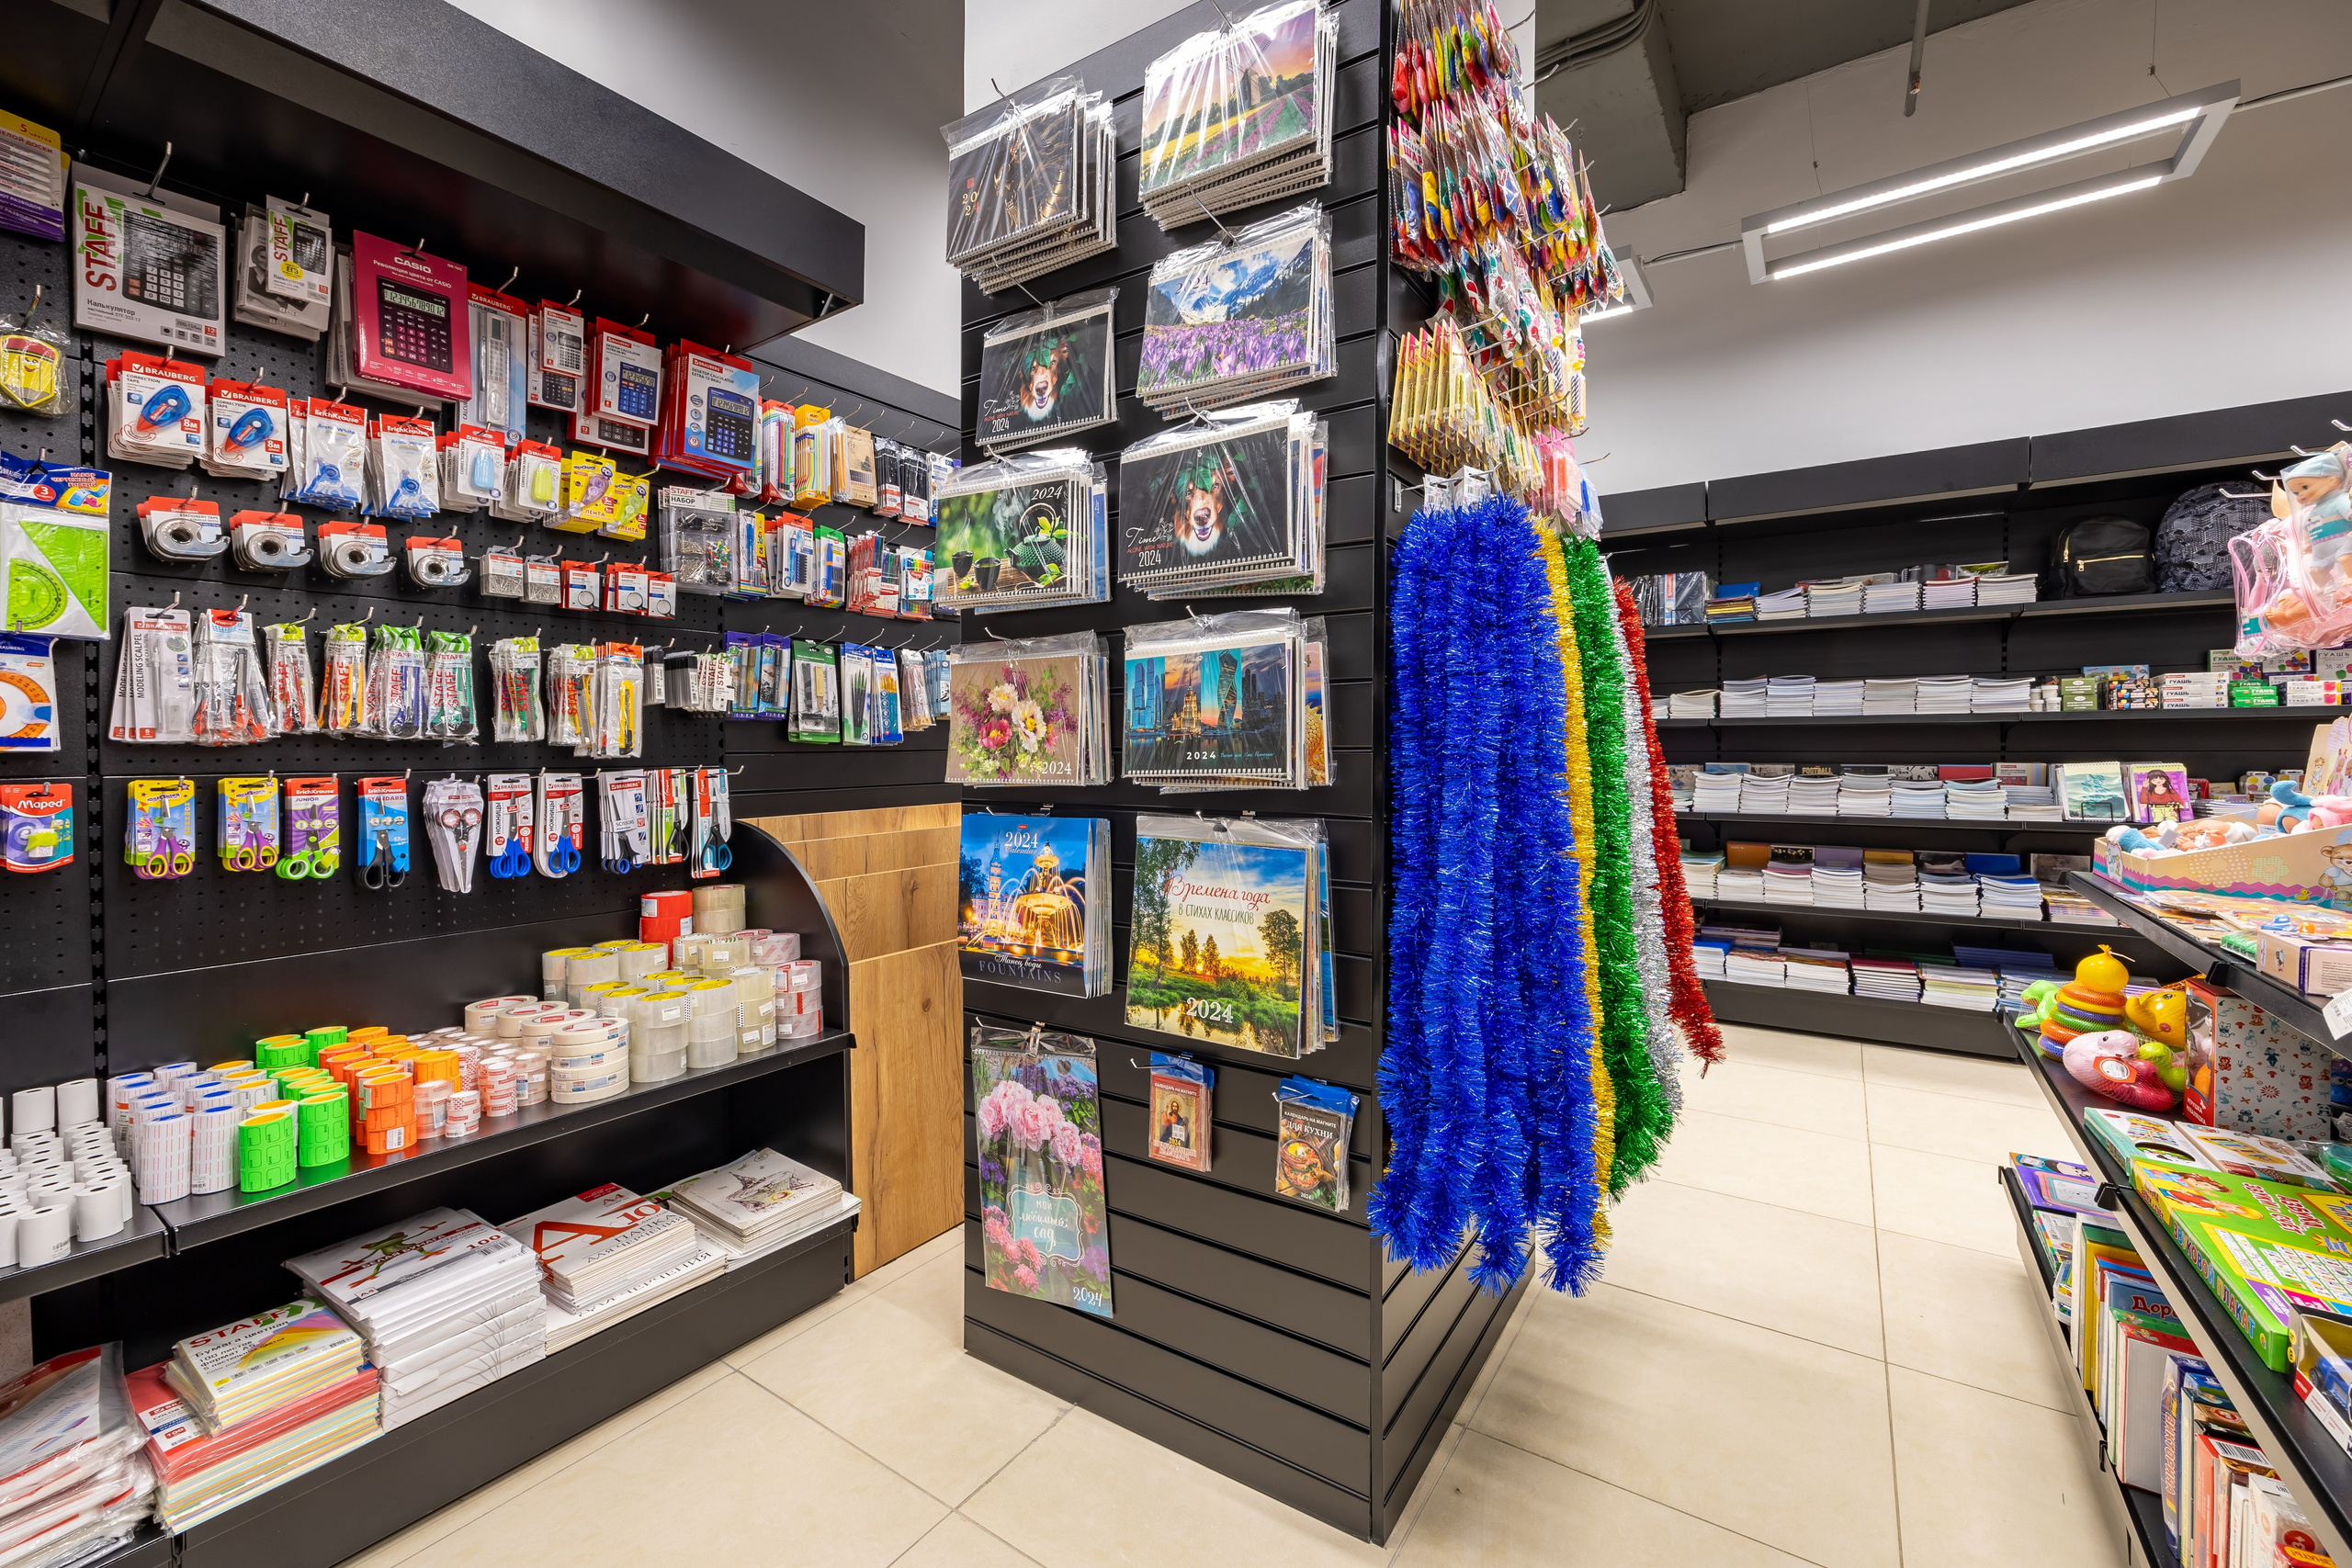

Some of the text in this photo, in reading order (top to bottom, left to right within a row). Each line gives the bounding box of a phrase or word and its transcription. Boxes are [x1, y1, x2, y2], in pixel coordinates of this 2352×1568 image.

[20, 123, 28, 133] 5
[26, 139, 53, 154] ДОСКИ
[7, 194, 45, 212] РАЗВОДОВ!
[961, 191, 978, 205] 20
[84, 199, 117, 291] STAFF
[274, 216, 288, 263] STAFF
[286, 265, 300, 276] ЕГЭ
[393, 256, 432, 274] CASIO
[373, 259, 409, 276] Революция
[410, 267, 424, 279] цвета
[434, 278, 452, 289] CASIO
[86, 299, 136, 316] Калькулятор
[479, 296, 514, 312] BRAUBERG
[86, 307, 120, 319] настольный
[205, 325, 217, 336] 12
[697, 359, 723, 373] BRAUBERG
[126, 374, 161, 384] CORRECTION
[144, 367, 198, 383] BRAUBERG
[361, 374, 401, 387] CASIO
[692, 367, 734, 385] DESKTOP CALCULATOR
[232, 391, 278, 406] BRAUBERG
[314, 409, 360, 423] ErichKrause
[983, 399, 1012, 417] Time
[183, 418, 198, 430] 8м
[387, 424, 430, 436] ErichKrause
[991, 417, 1011, 433] 2024
[267, 440, 282, 451] 8м
[472, 435, 499, 446] BRAUBERG
[532, 449, 556, 460] BRAUBERG
[40, 486, 49, 495] 3
[671, 487, 695, 496] STAFF
[1031, 484, 1064, 501] 2024
[671, 495, 695, 505] НАБОР
[584, 509, 606, 518] ЛЕНТА
[620, 525, 639, 534] ЛЕНТА
[1125, 526, 1160, 548] Time
[1126, 546, 1142, 555] ALONE
[1157, 541, 1174, 549] NATURE
[1138, 549, 1162, 568] 2024
[144, 623, 183, 631] BRAUBERG
[717, 660, 725, 686] STAFF
[137, 668, 145, 699] MODELING
[444, 671, 457, 707] STAFF
[517, 673, 528, 712] STAFF
[568, 678, 578, 716] STAFF
[1186, 750, 1216, 761] 2024
[1042, 761, 1073, 776] 2024
[1802, 767, 1832, 775] FOOTBALL
[615, 782, 640, 790] BRAUBERG
[17, 797, 66, 810] Maped
[368, 795, 405, 803] STANDARD
[184, 801, 192, 836] НОЖНИЦЫ
[616, 819, 635, 828] SCISSORS
[1004, 831, 1039, 850] 2024
[1004, 845, 1038, 855] Calendar
[1163, 868, 1272, 912] Времена года
[1178, 902, 1255, 925] В СТИХАХ КЛАССИКОВ
[978, 959, 1062, 985] FOUNTAINS
[1186, 997, 1234, 1024] 2024
[1154, 1082, 1175, 1091] КАЛЕНДАРЬ
[1283, 1111, 1309, 1122] КАЛЕНДАРЬ
[1317, 1118, 1337, 1129] МАГНИТЕ
[1286, 1121, 1333, 1140] ДЛЯ КУХНИ
[602, 1193, 625, 1206] A4
[1035, 1198, 1053, 1211] МОЙ
[616, 1203, 662, 1225] 10
[615, 1213, 677, 1243] ПАПКА
[1017, 1212, 1069, 1234] любимый
[440, 1225, 482, 1245] СТАНДАРТ
[467, 1234, 502, 1250] 100
[586, 1215, 684, 1264] ДЛЯ ЧЕРЧЕНИЯ
[1033, 1224, 1057, 1253] сад
[361, 1234, 447, 1269] БЕЛАЯ БУМАГА
[2173, 1221, 2256, 1339] ЗВУКОВОЙ ПЛАКАТ
[359, 1288, 376, 1297] A4
[1072, 1285, 1103, 1308] 2024
[189, 1306, 292, 1348] STAFF
[195, 1320, 289, 1359] Бумага цветная
[199, 1340, 253, 1363] 100 листов
[199, 1352, 240, 1368] формат
[167, 1427, 184, 1438] 100
[2165, 1412, 2177, 1496] ВИКТОРИНА
